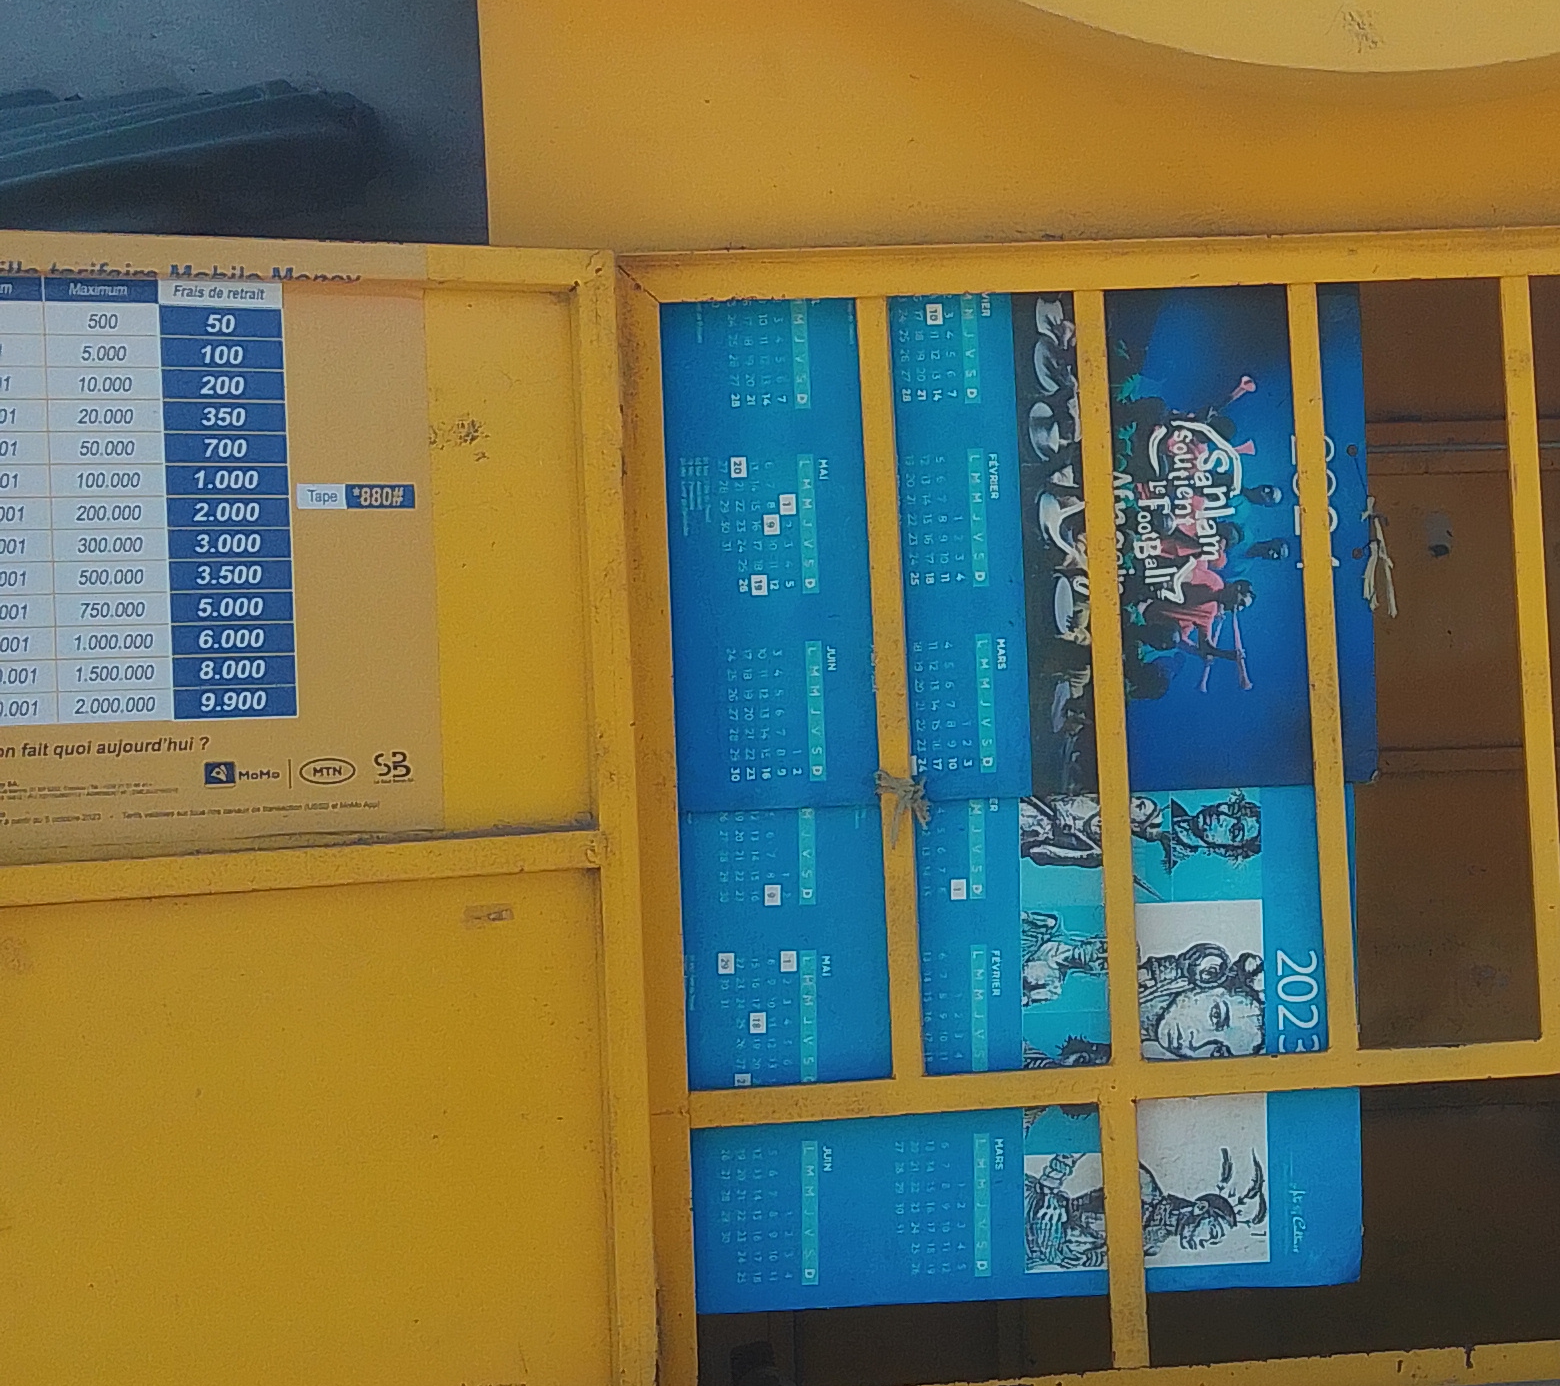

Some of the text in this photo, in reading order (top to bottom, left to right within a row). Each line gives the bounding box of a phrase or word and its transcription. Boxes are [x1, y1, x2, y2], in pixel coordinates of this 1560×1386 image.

[69, 282, 128, 297] Maximum
[173, 285, 265, 300] Frais de retrait
[87, 314, 119, 330] 500
[205, 314, 236, 334] 50
[929, 308, 938, 322] 10
[81, 346, 127, 362] 5.000
[201, 346, 243, 365] 100
[78, 376, 132, 393] 10.000
[200, 376, 245, 395] 200
[77, 409, 133, 425] 20.000
[202, 408, 246, 427] 350
[79, 440, 135, 457] 50.000
[204, 439, 248, 458] 700
[733, 460, 743, 475] 20
[818, 459, 829, 480] MAI
[988, 453, 999, 500] FÉVRIER
[76, 472, 141, 489] 100.000
[194, 470, 259, 489] 1.000
[307, 489, 338, 505] Tape
[75, 505, 142, 522] 200.000
[193, 502, 260, 521] 2.000
[77, 537, 143, 554] 300.000
[195, 534, 261, 553] 3.000
[78, 569, 144, 586] 500.000
[196, 565, 262, 585] 3.500
[80, 601, 146, 619] 750.000
[197, 597, 264, 617] 5.000
[74, 633, 154, 651] 1.000.000
[199, 628, 265, 648] 6.000
[826, 646, 837, 671] JUIN
[996, 639, 1006, 670] MARS
[75, 664, 155, 683] 1.500.000
[199, 660, 266, 680] 8.000
[74, 696, 156, 715] 2.000.000
[200, 691, 267, 711] 9.900
[21, 742, 49, 757] fait
[54, 740, 92, 759] quoi
[238, 769, 280, 781] MoMo
[312, 765, 343, 778] MTN
[821, 955, 831, 977] MAI
[822, 1146, 832, 1172] JUIN
[994, 1138, 1004, 1171] MARS
